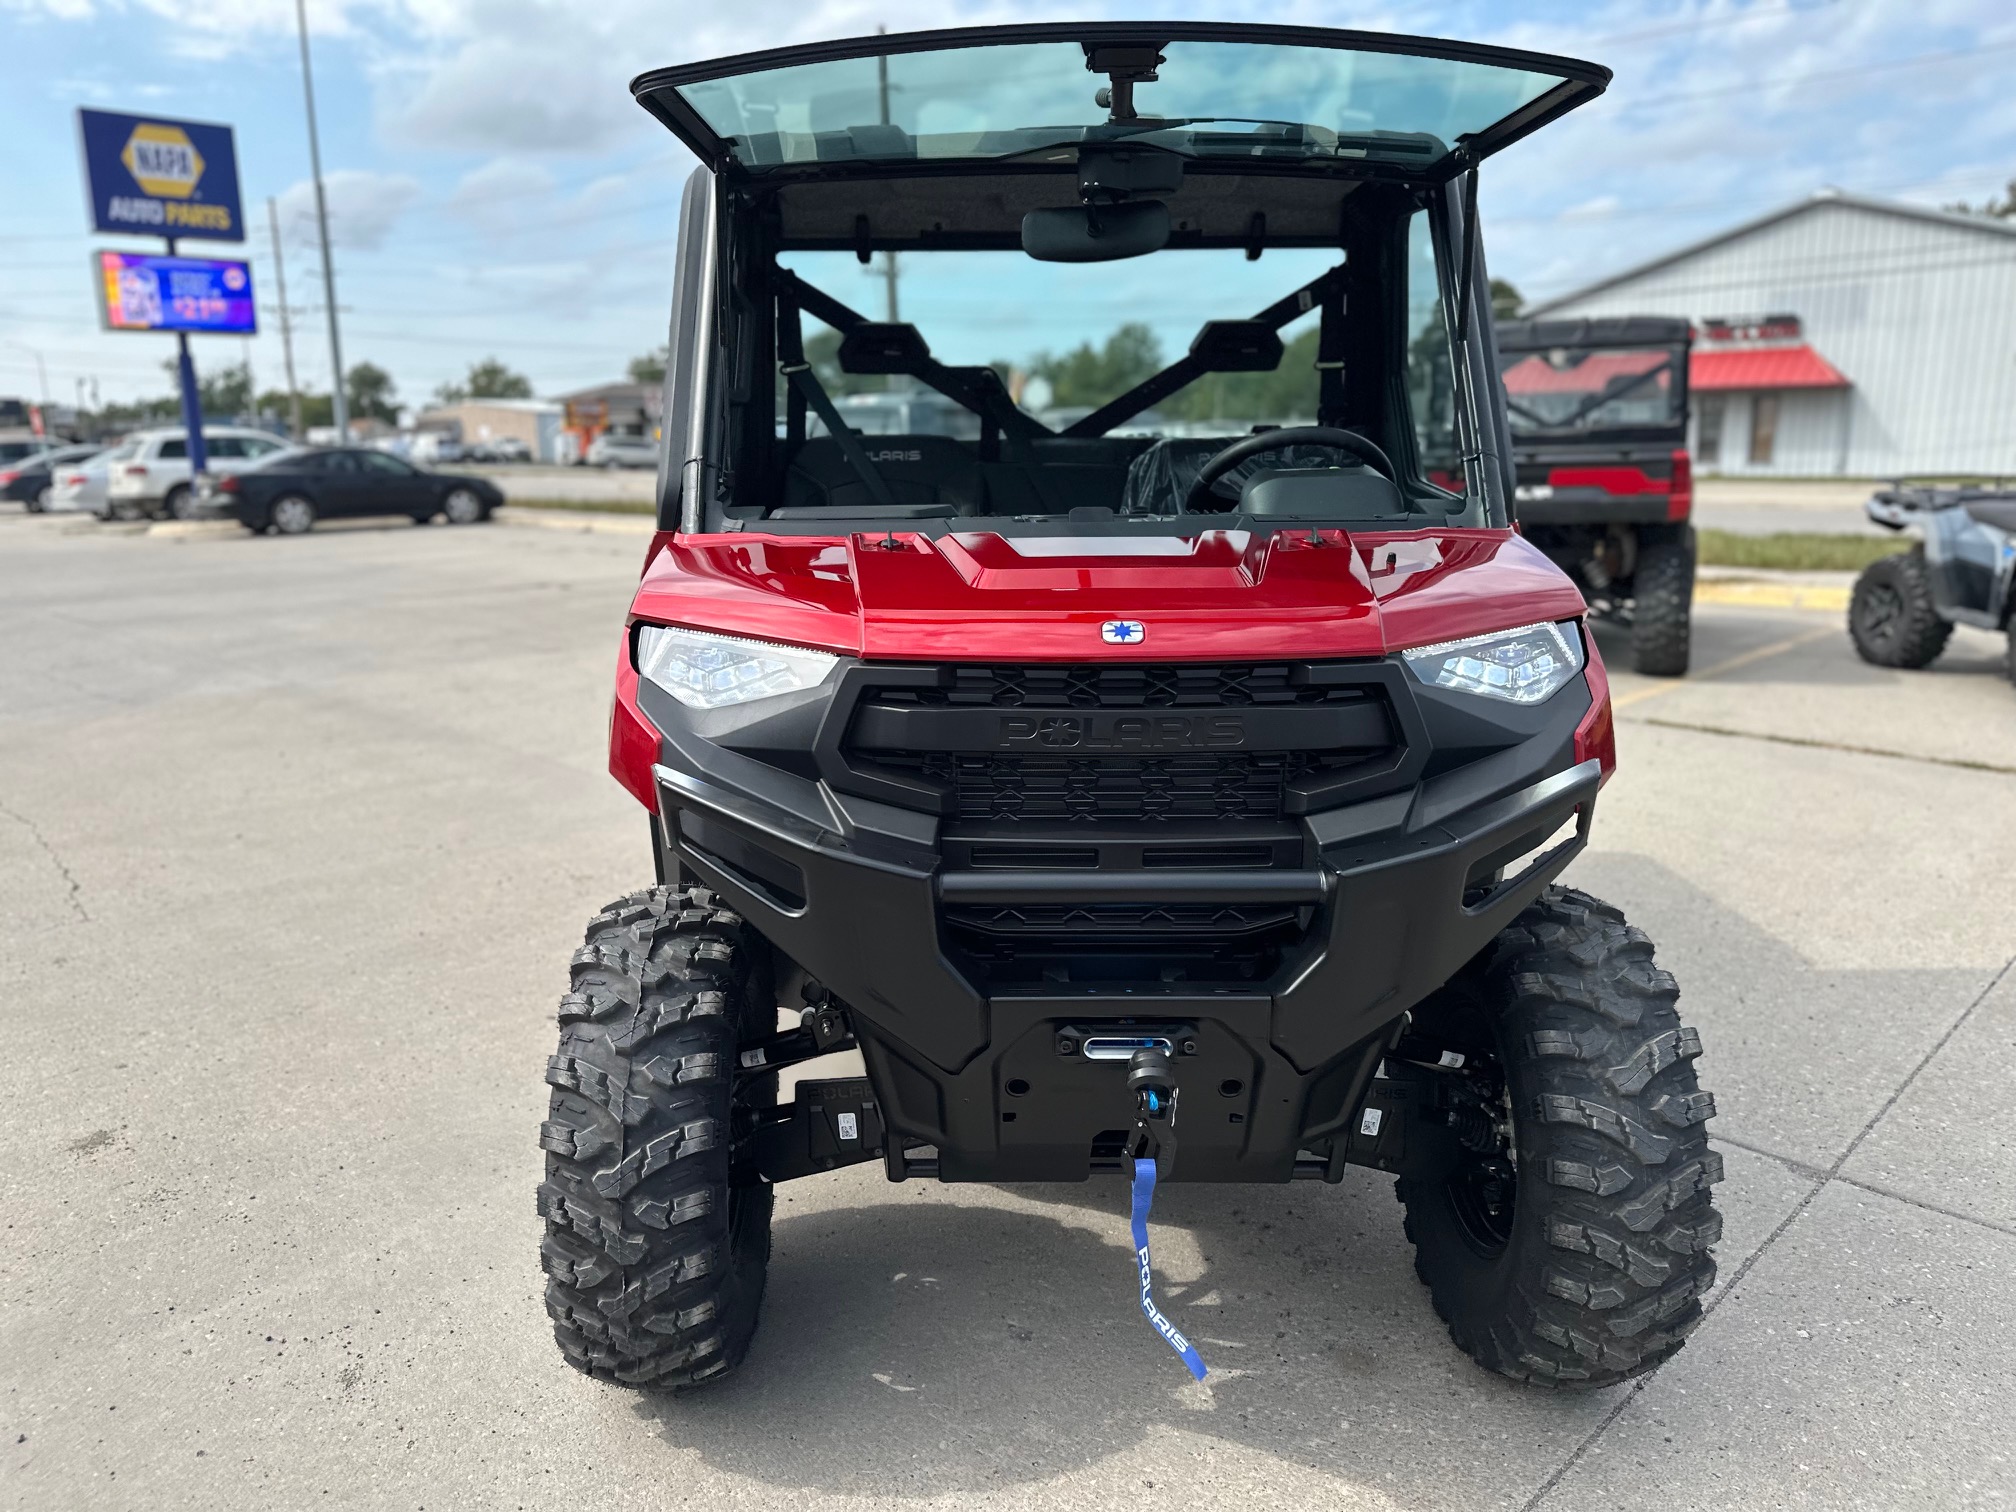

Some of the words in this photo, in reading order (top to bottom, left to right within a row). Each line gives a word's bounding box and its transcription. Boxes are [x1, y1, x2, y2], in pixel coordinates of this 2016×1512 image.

[135, 144, 192, 177] NAPA
[109, 196, 163, 225] AUTO
[165, 201, 231, 230] PARTS
[1000, 716, 1246, 748] POLARIS
[1138, 1246, 1189, 1353] POLARIS
